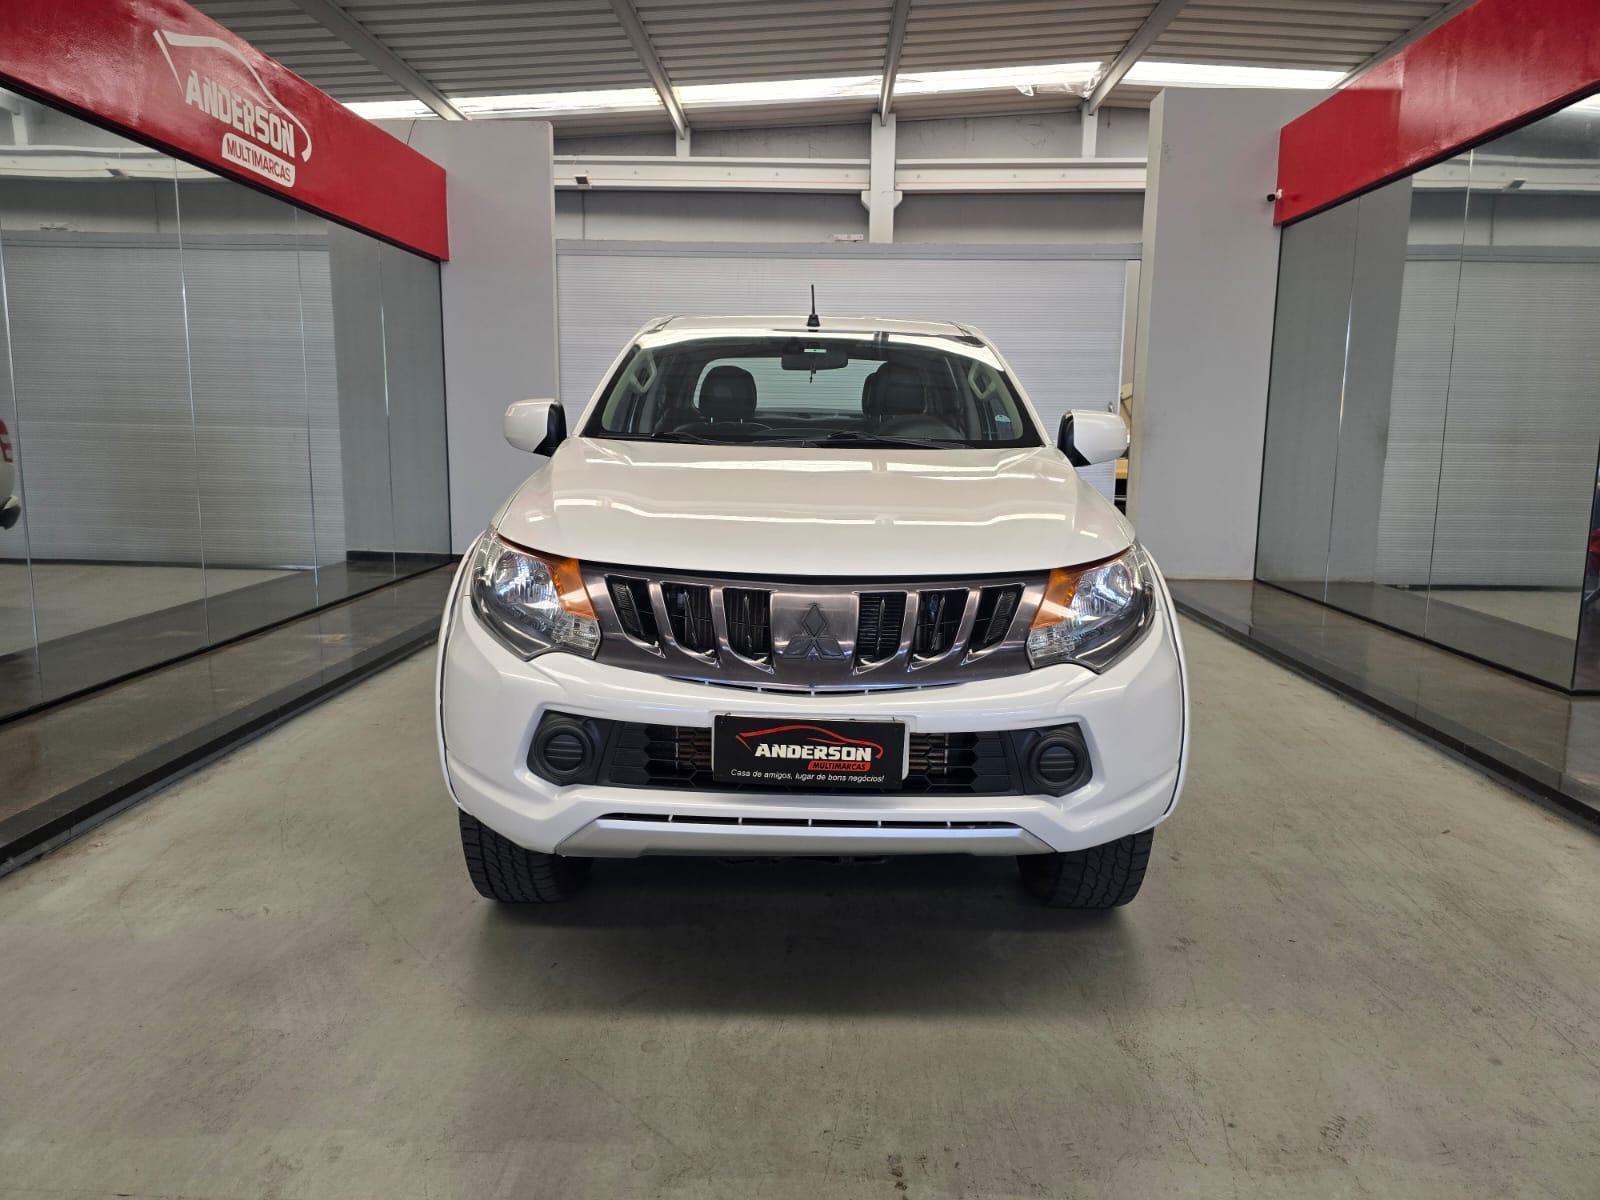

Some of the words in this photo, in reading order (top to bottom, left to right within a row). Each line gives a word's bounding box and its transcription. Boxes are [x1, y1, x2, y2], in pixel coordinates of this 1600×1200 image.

[185, 70, 295, 158] ANDERSON
[226, 139, 292, 182] MULTIMARCAS
[755, 743, 872, 762] ANDERSON
[730, 768, 751, 777] Casa
[752, 770, 762, 778] de
[763, 771, 793, 780] amigos,
[795, 771, 815, 781] lugar
[828, 773, 847, 781] bons
[848, 774, 885, 783] negócios!
[812, 762, 866, 770] MULTIMARCAS
